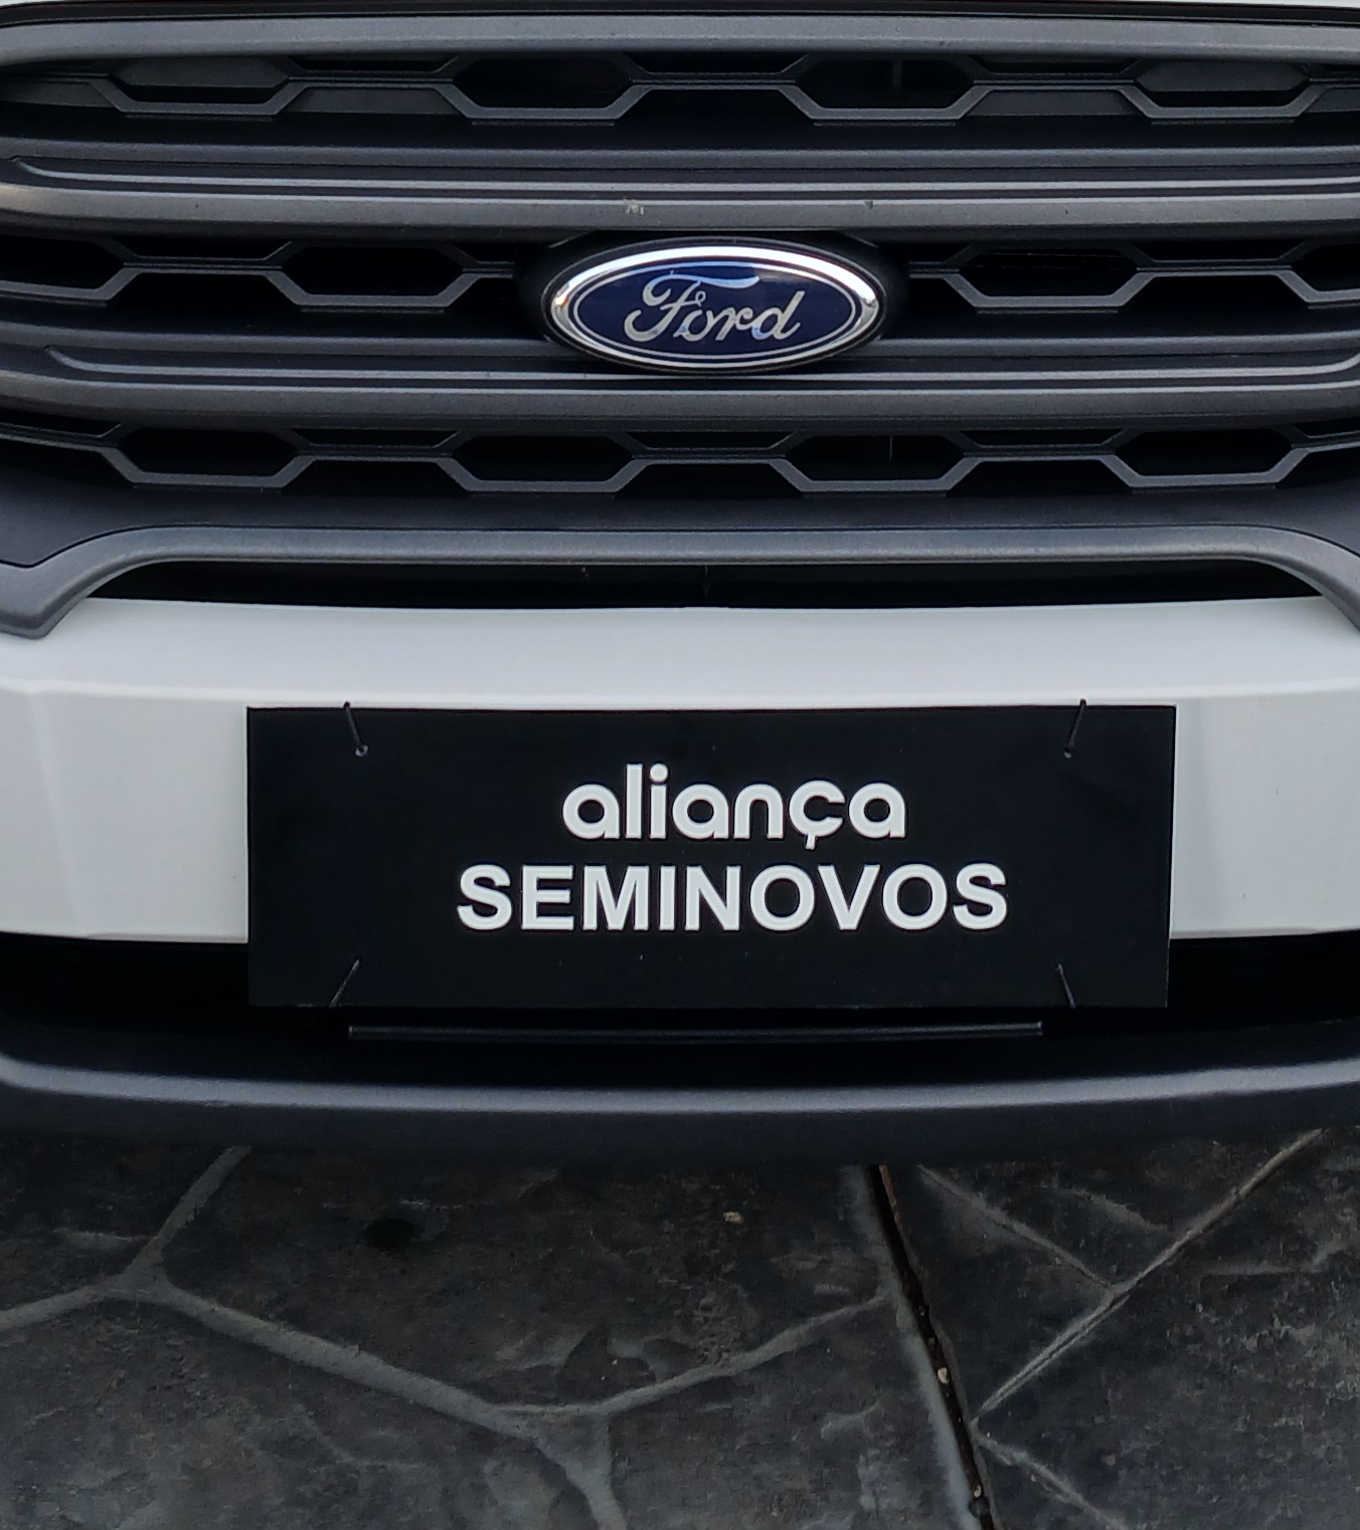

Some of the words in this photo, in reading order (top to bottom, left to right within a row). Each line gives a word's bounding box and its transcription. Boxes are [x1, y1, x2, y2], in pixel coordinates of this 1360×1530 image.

[624, 270, 805, 342] Ford
[563, 763, 907, 849] aliança
[457, 863, 1009, 933] SEMINOVOS
